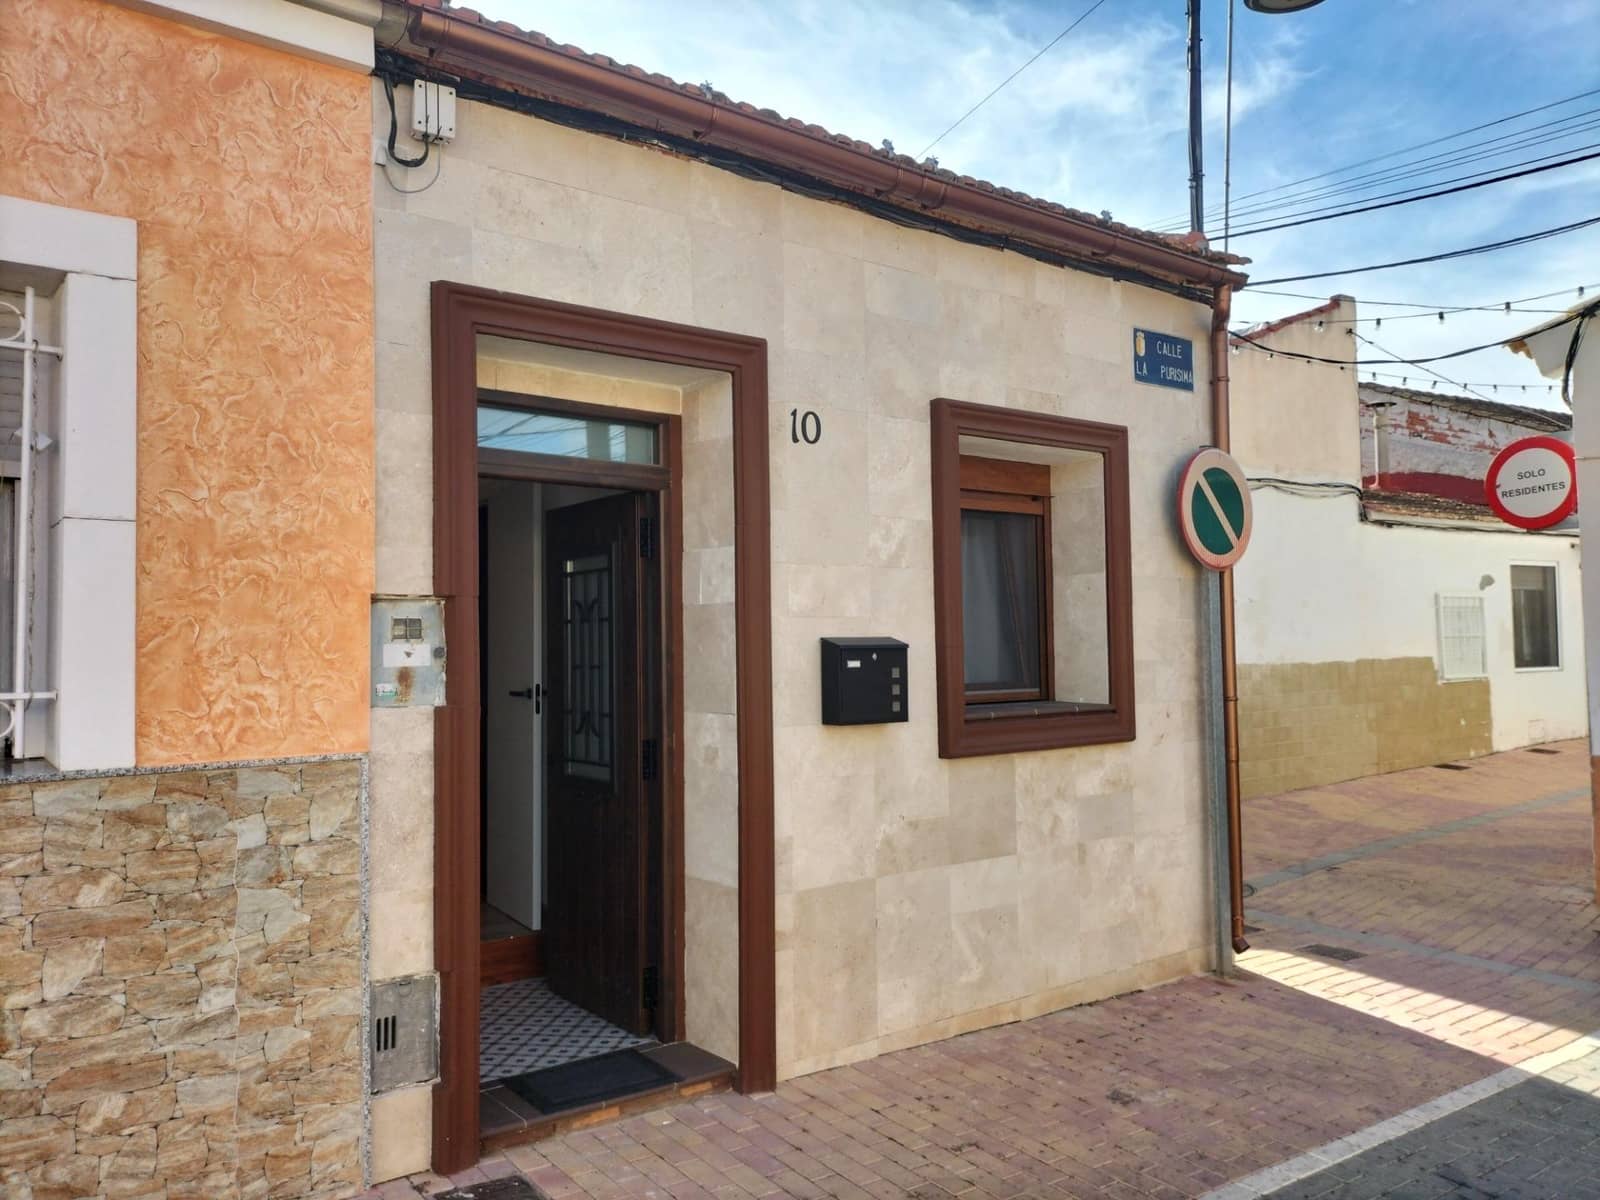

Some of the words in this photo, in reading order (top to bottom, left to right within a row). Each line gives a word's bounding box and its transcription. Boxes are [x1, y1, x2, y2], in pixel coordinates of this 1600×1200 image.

[1156, 340, 1182, 359] CALLE
[1136, 360, 1148, 377] LA
[1160, 365, 1193, 384] PURISIMA
[790, 408, 822, 445] 10
[1516, 468, 1546, 480] SOLO
[1501, 481, 1566, 499] RESIDENTES
